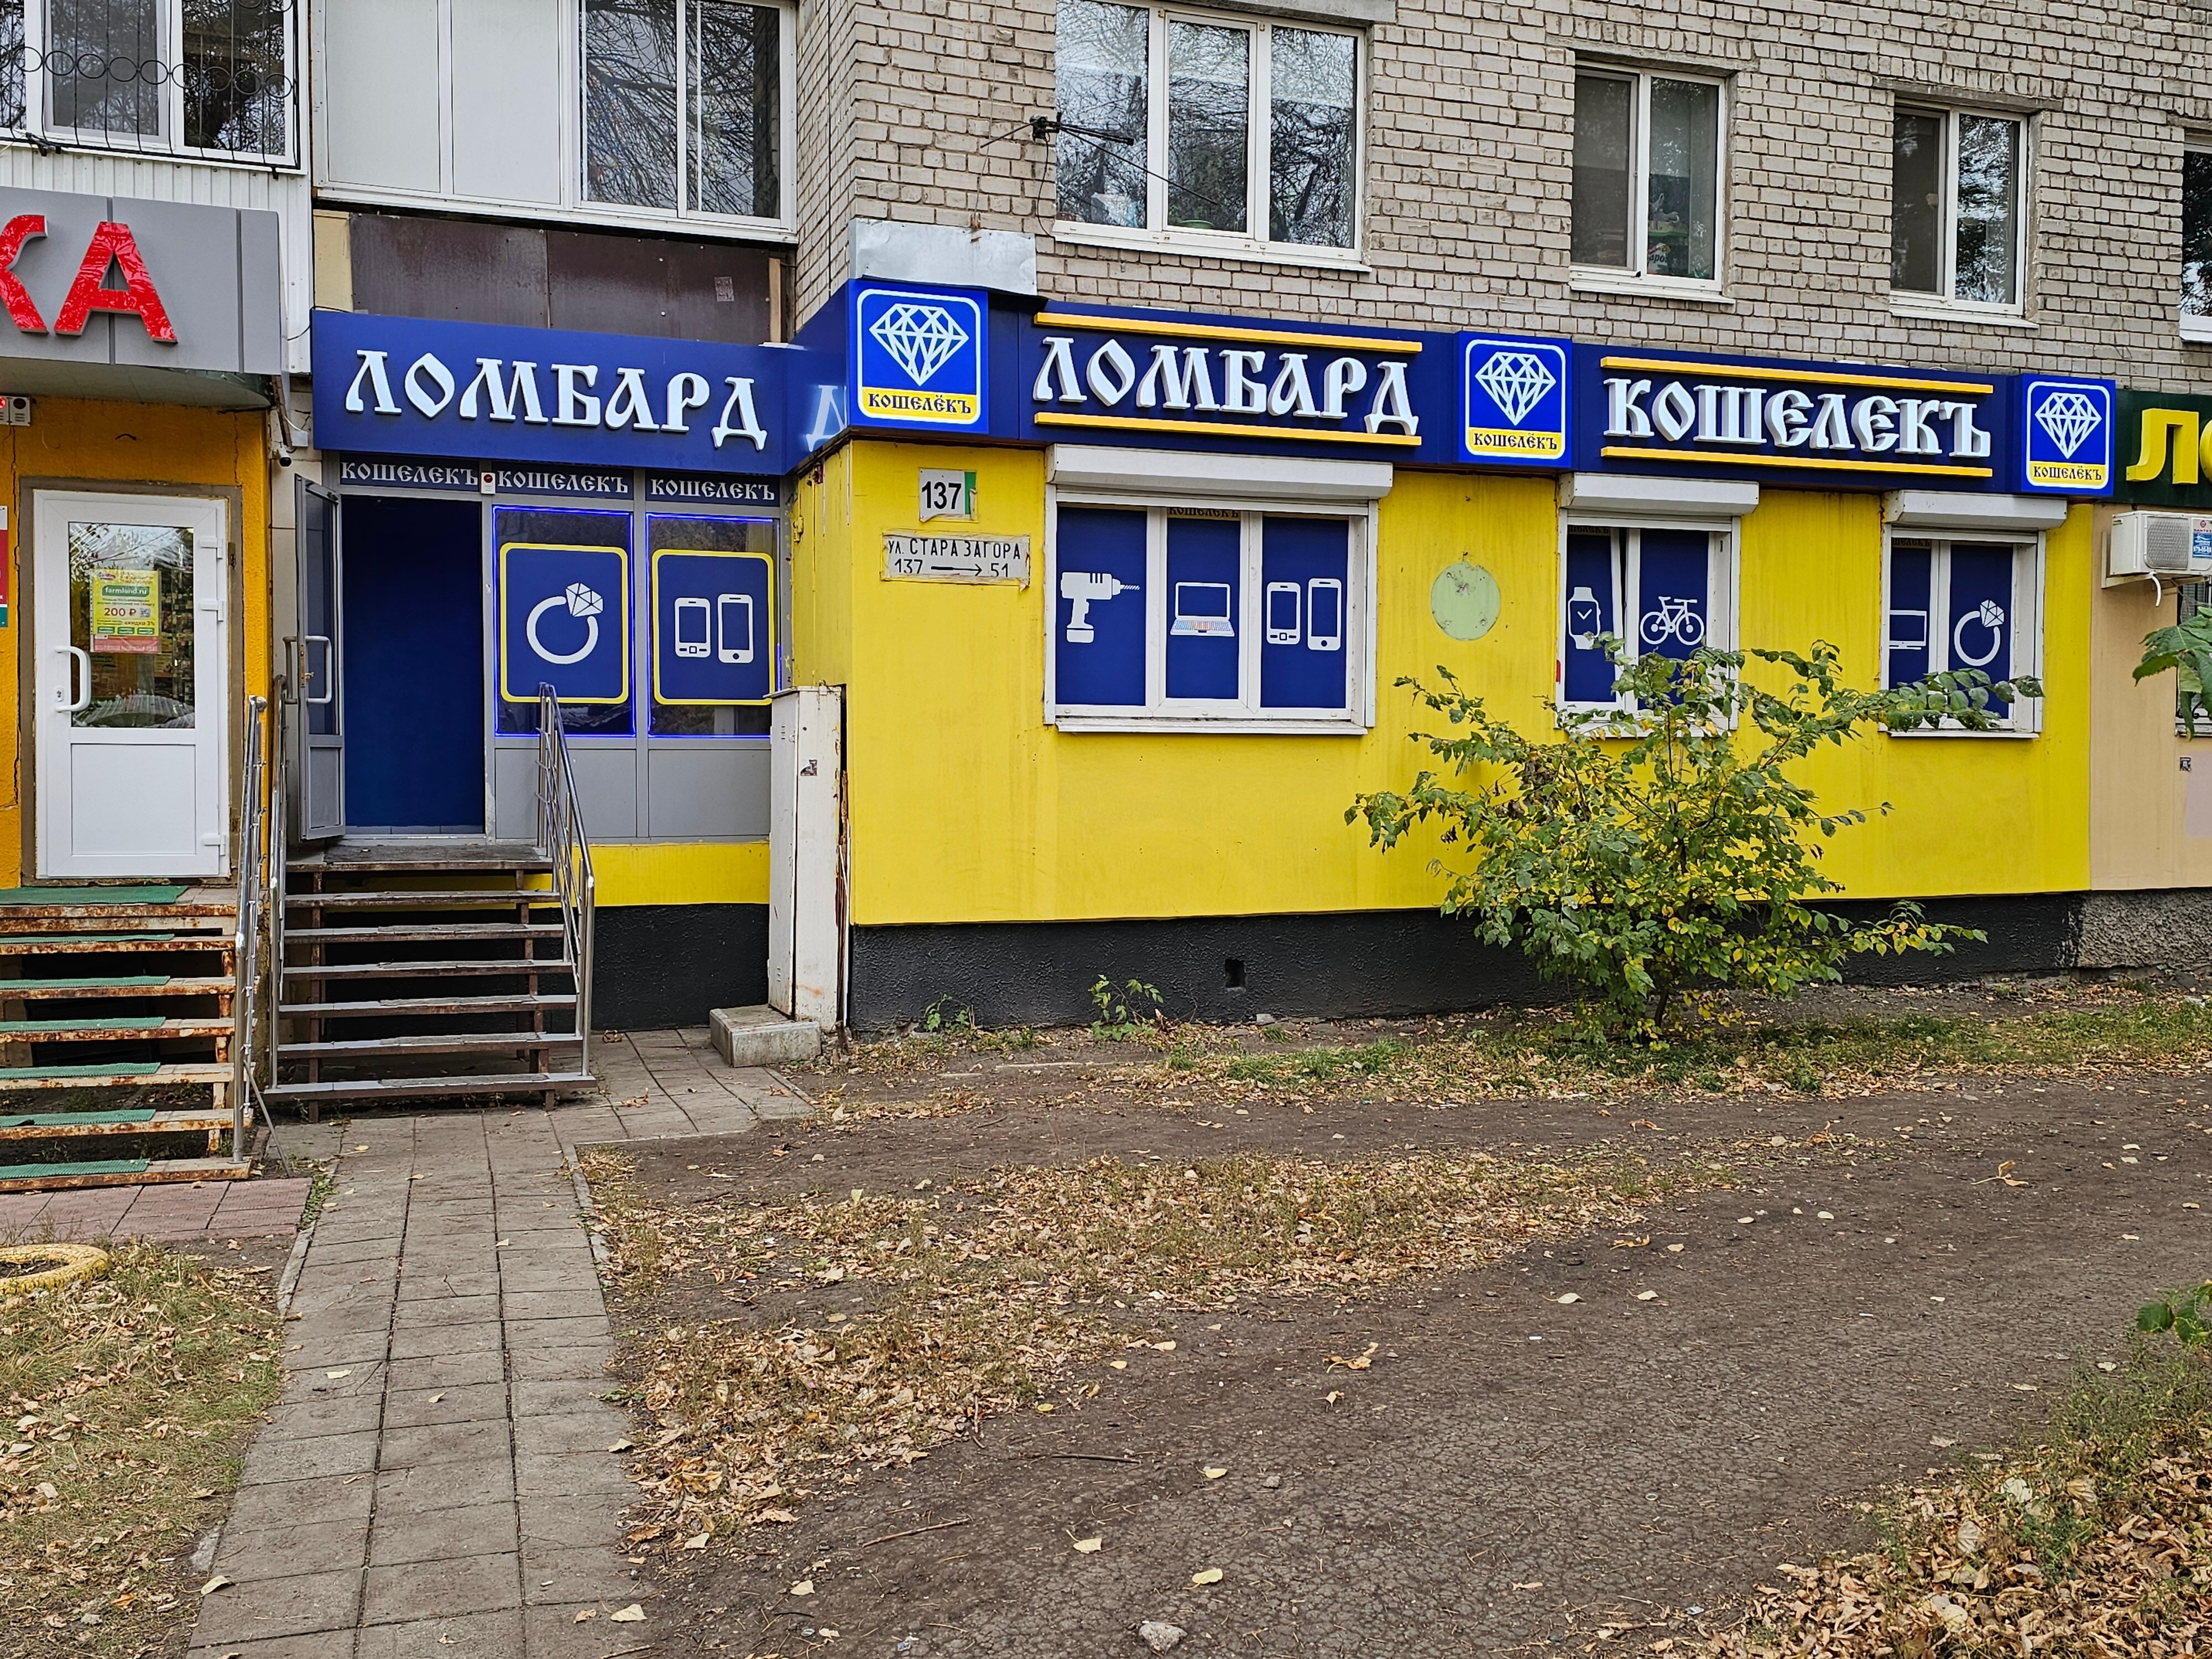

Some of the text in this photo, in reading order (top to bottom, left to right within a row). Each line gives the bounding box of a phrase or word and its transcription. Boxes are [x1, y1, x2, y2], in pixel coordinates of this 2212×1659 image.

[1032, 336, 1419, 436] ЛОМБАРД
[346, 349, 768, 451] ЛОМБАРД
[868, 393, 971, 414] КОШЕЛЁКЪ
[1603, 378, 1991, 458] КОШЕЛЕКЪ
[1473, 431, 1558, 451] КОШЕЛЁКЪ
[2126, 408, 2212, 485] Л
[341, 462, 478, 486] КОШЕЛЕКЪ
[498, 470, 628, 494] КОШЕЛЕКЪ
[2033, 465, 2102, 481] КОШЕЛЁКЪ
[650, 478, 775, 500] КОШЕЛЕКЪ
[921, 481, 962, 509] 137
[910, 538, 958, 557] СТАРА
[964, 540, 1021, 560] ЗАГОРА
[894, 559, 1009, 577] 137 51
[104, 607, 126, 617] 200
